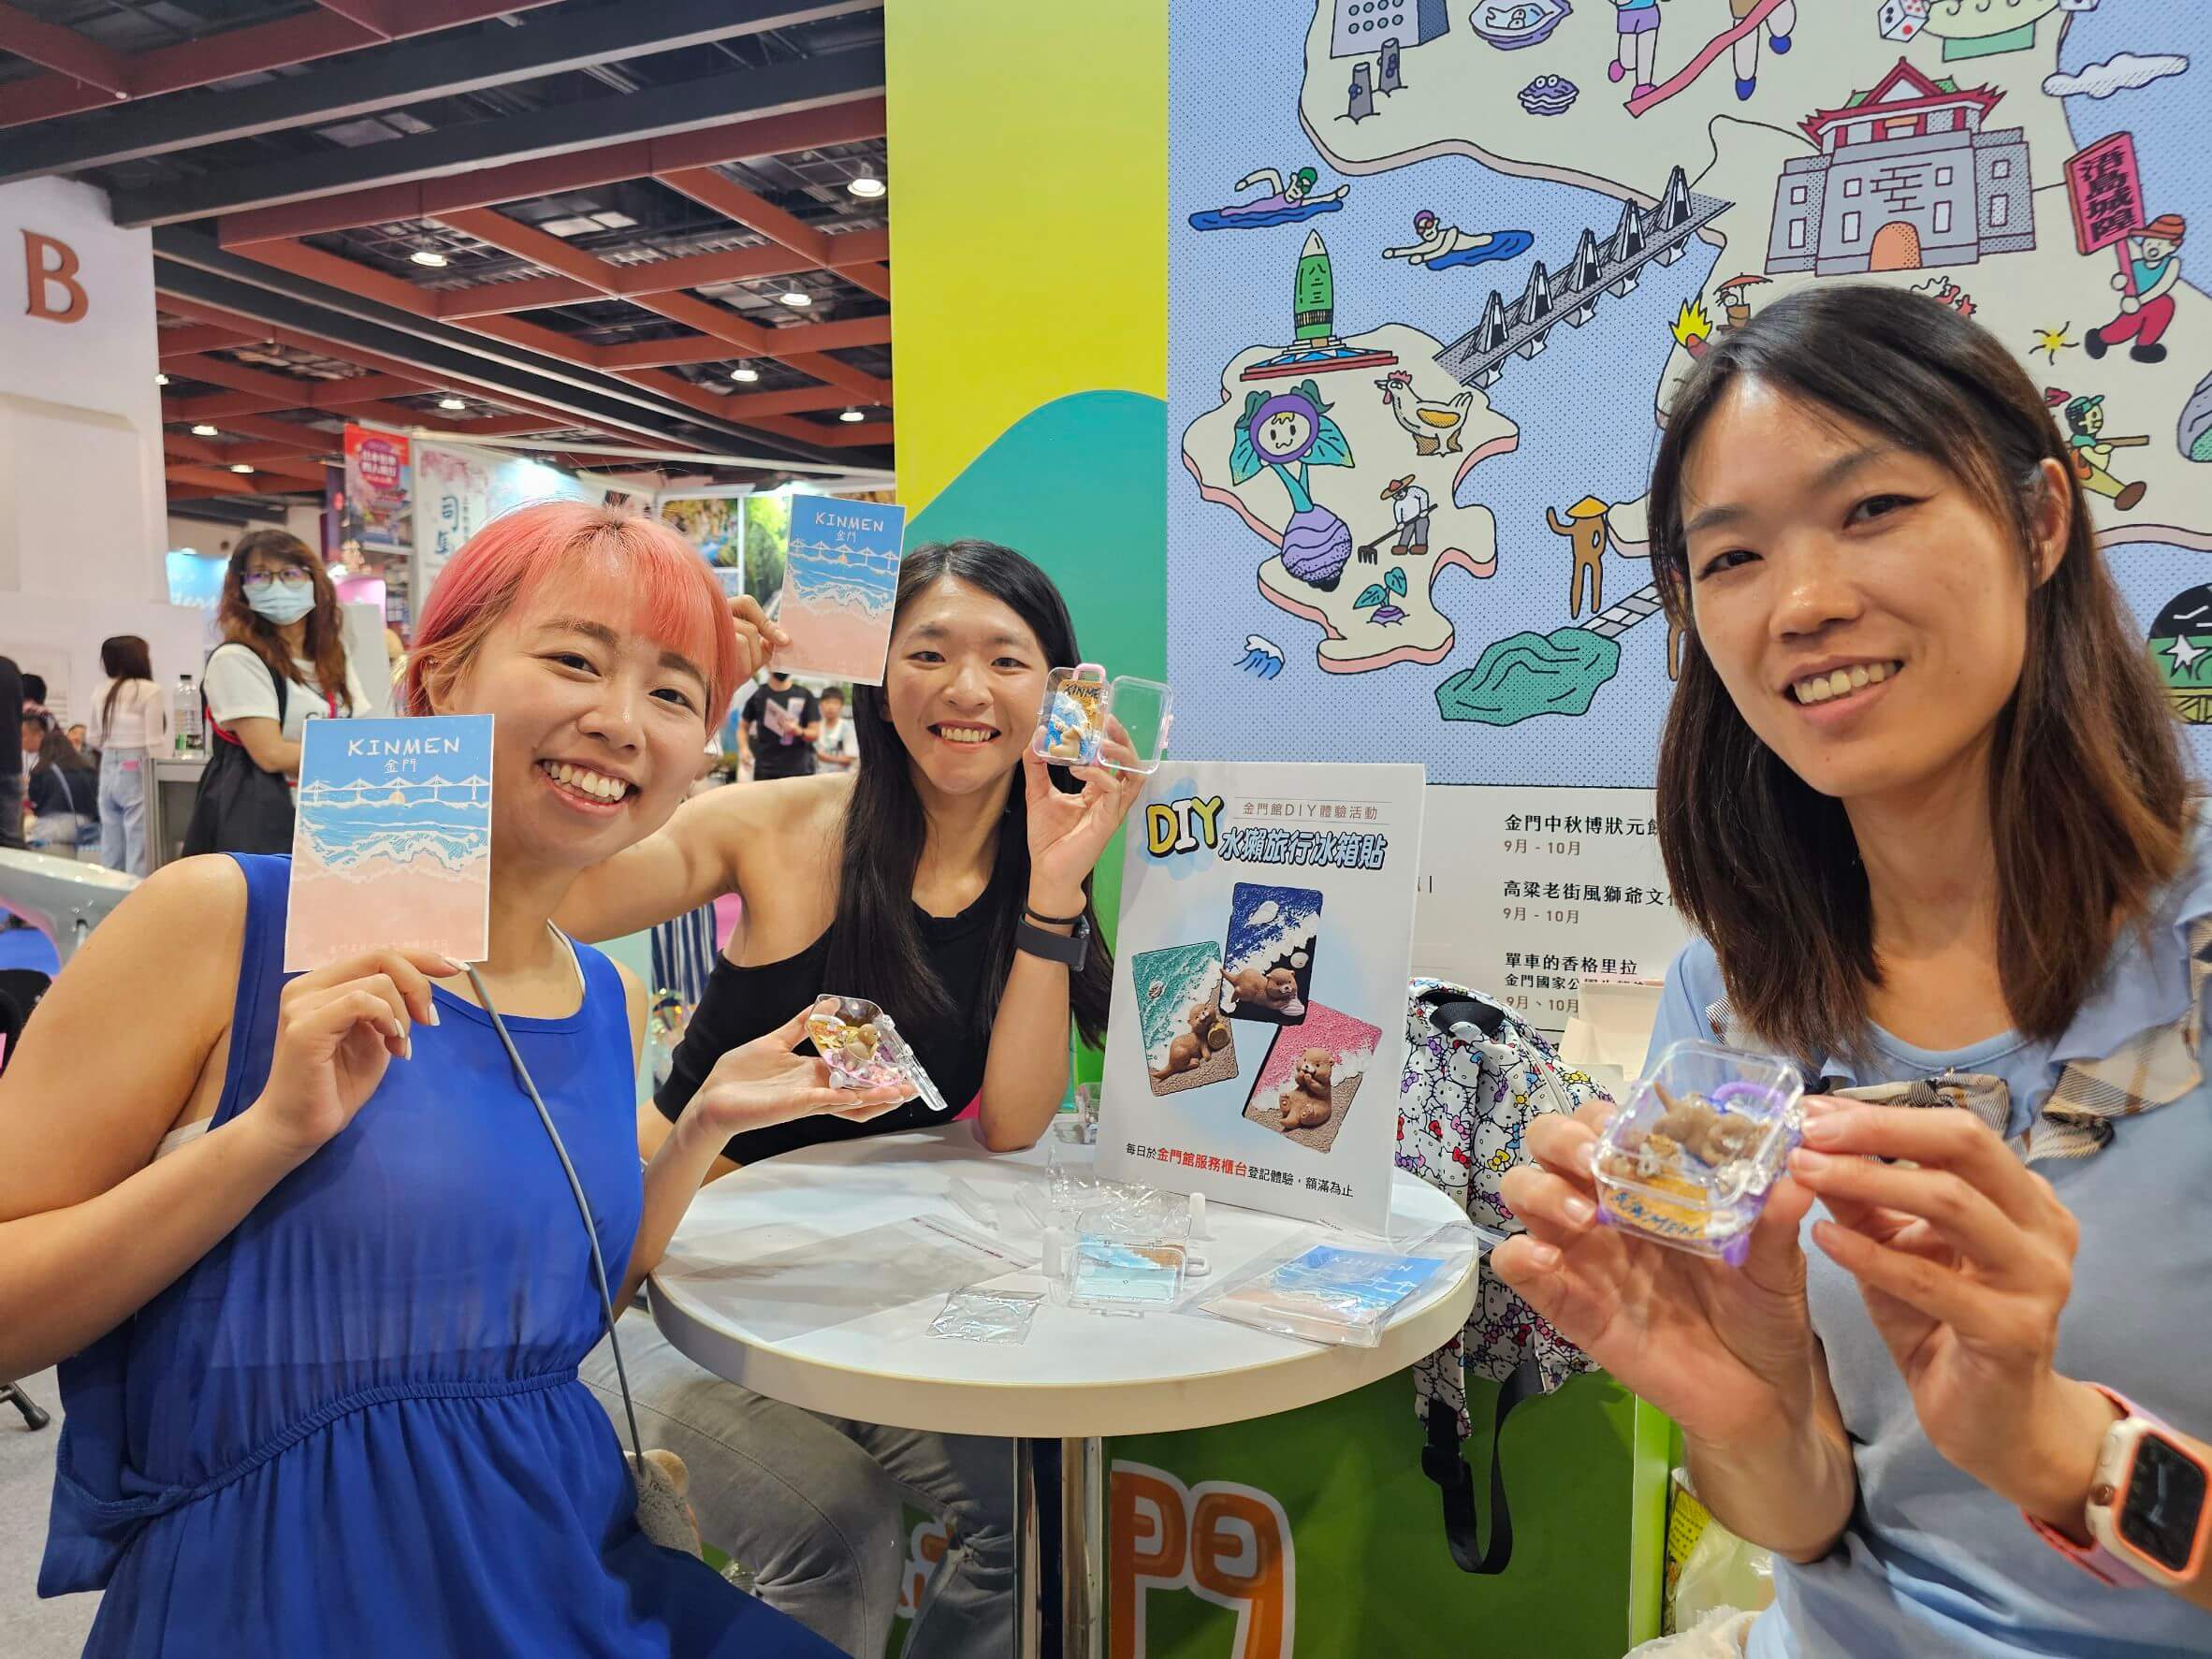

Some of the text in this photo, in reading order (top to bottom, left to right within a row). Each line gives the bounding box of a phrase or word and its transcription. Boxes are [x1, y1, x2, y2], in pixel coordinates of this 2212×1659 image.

[19, 227, 89, 324] B
[815, 512, 884, 531] KINMEN
[836, 531, 857, 543] 金門
[347, 736, 459, 757] KINMEN
[384, 758, 417, 774] 金門
[1242, 802, 1378, 821] 金門館DIY體驗活動
[1145, 795, 1225, 858] DIY
[1218, 827, 1389, 870] 水獺旅行冰箱貼
[1504, 838, 1528, 854] 9月
[1548, 841, 1581, 856] 10月
[1503, 907, 1527, 922] 9月
[1547, 910, 1579, 924] 10月
[1505, 952, 1638, 975] 單車的香格里拉
